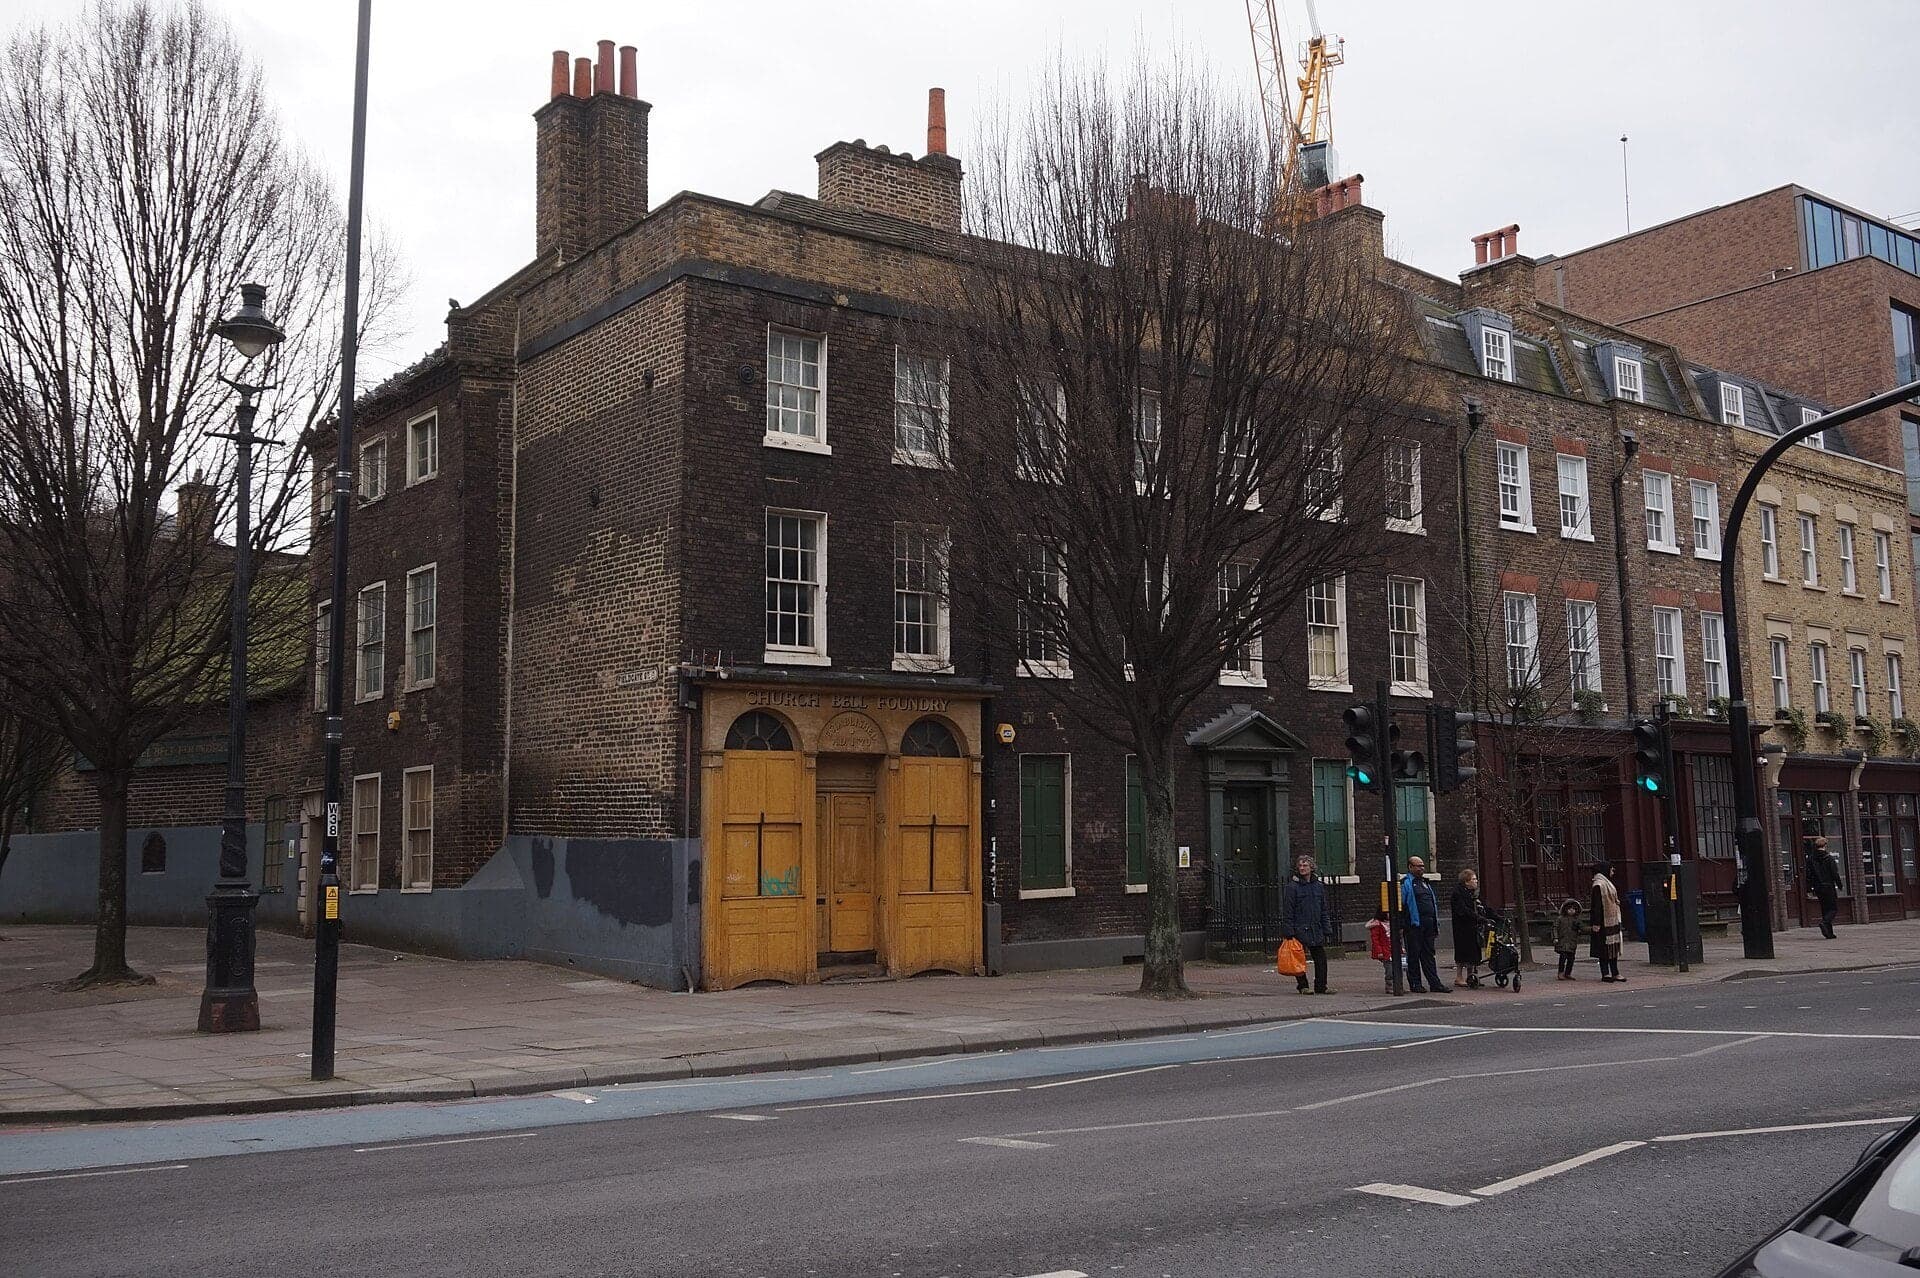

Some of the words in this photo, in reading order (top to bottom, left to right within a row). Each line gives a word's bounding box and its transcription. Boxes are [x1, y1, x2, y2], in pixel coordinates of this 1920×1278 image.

[746, 690, 820, 708] CHURCH
[832, 695, 869, 710] BELL
[877, 696, 952, 713] FOUNDRY
